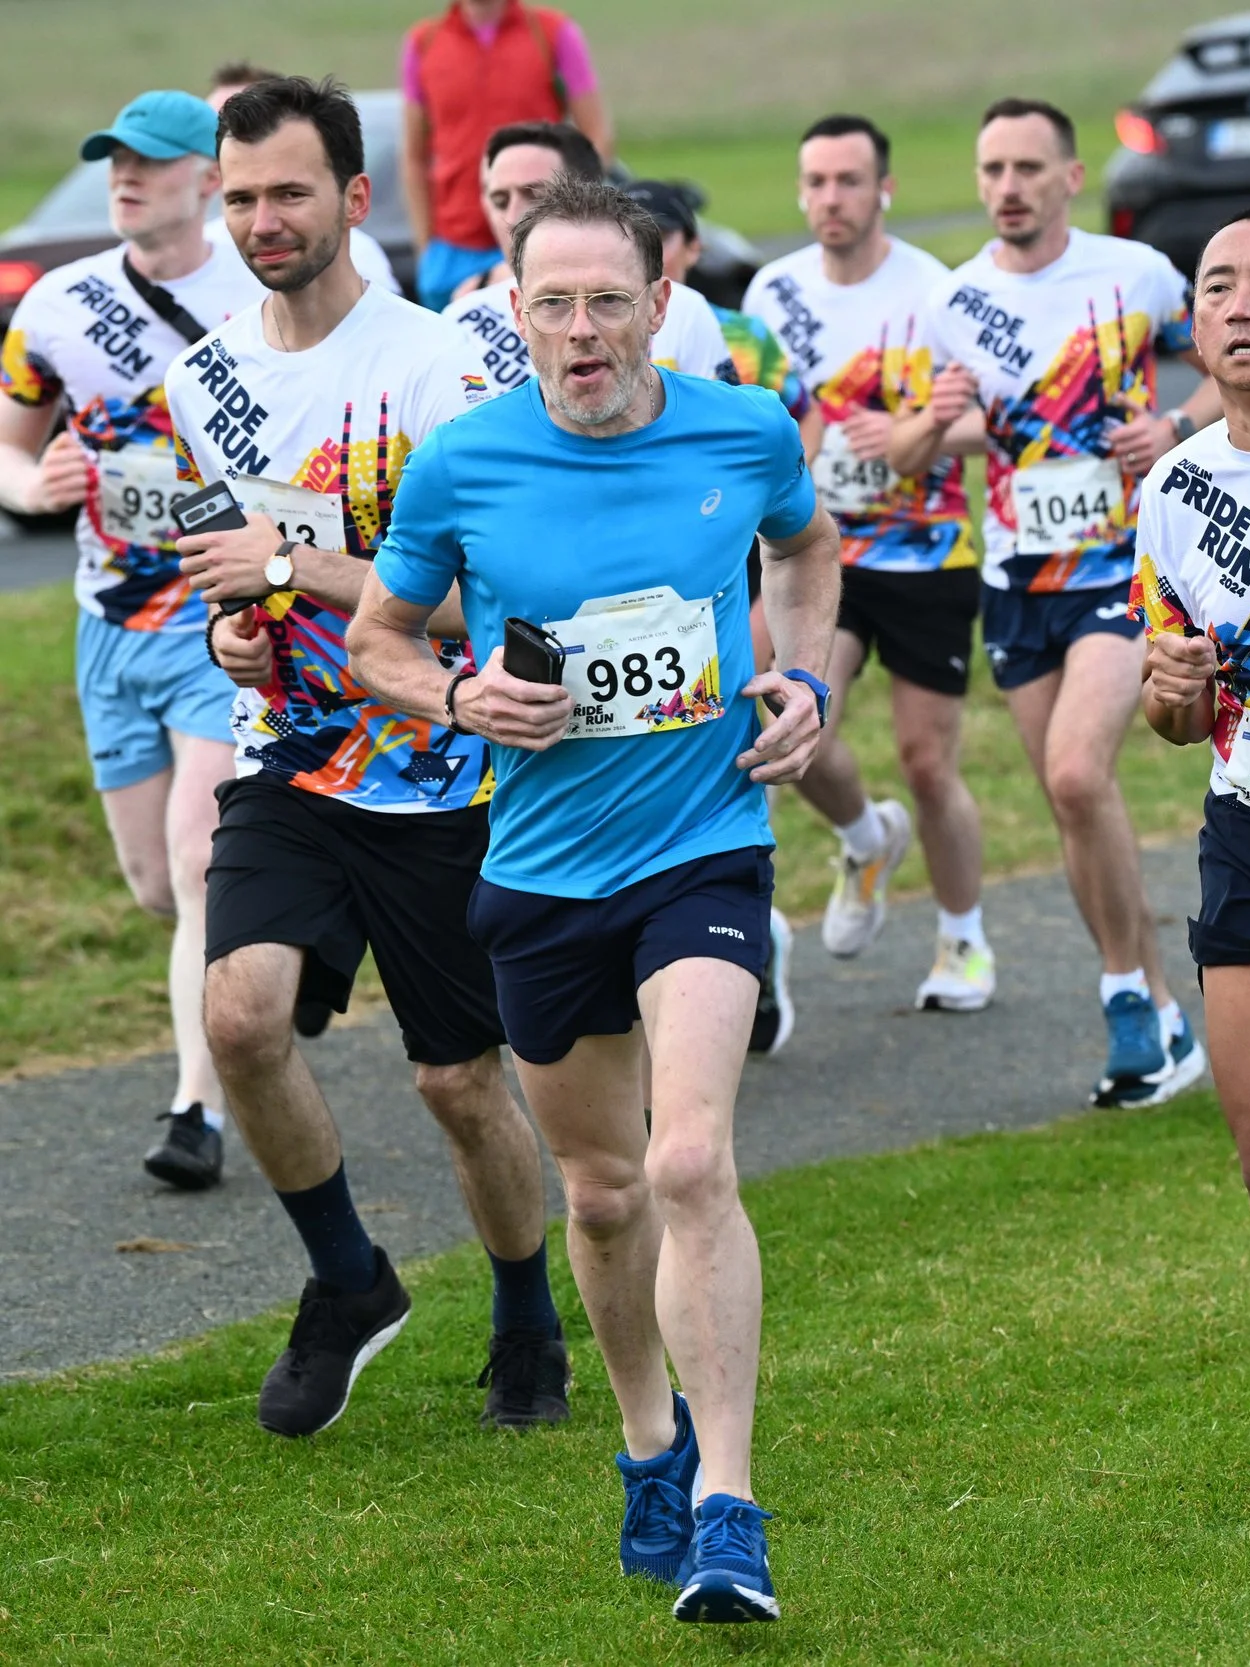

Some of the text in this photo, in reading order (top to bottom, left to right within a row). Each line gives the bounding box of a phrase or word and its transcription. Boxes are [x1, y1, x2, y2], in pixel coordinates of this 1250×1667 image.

[66, 281, 149, 339] PRIDE
[948, 290, 1025, 338] PRIDE
[84, 320, 152, 373] RUN
[976, 328, 1033, 369] RUN
[184, 344, 269, 437] PRIDE
[203, 407, 271, 476] RUN
[1177, 458, 1213, 482] DUBLIN
[1029, 487, 1109, 525] 1044
[1219, 573, 1247, 598] 2024
[677, 621, 708, 634] QUANTA
[586, 646, 686, 703] 983
[573, 704, 604, 717] RIDE
[585, 713, 614, 726] RUN
[708, 925, 745, 941] KIPSTA
